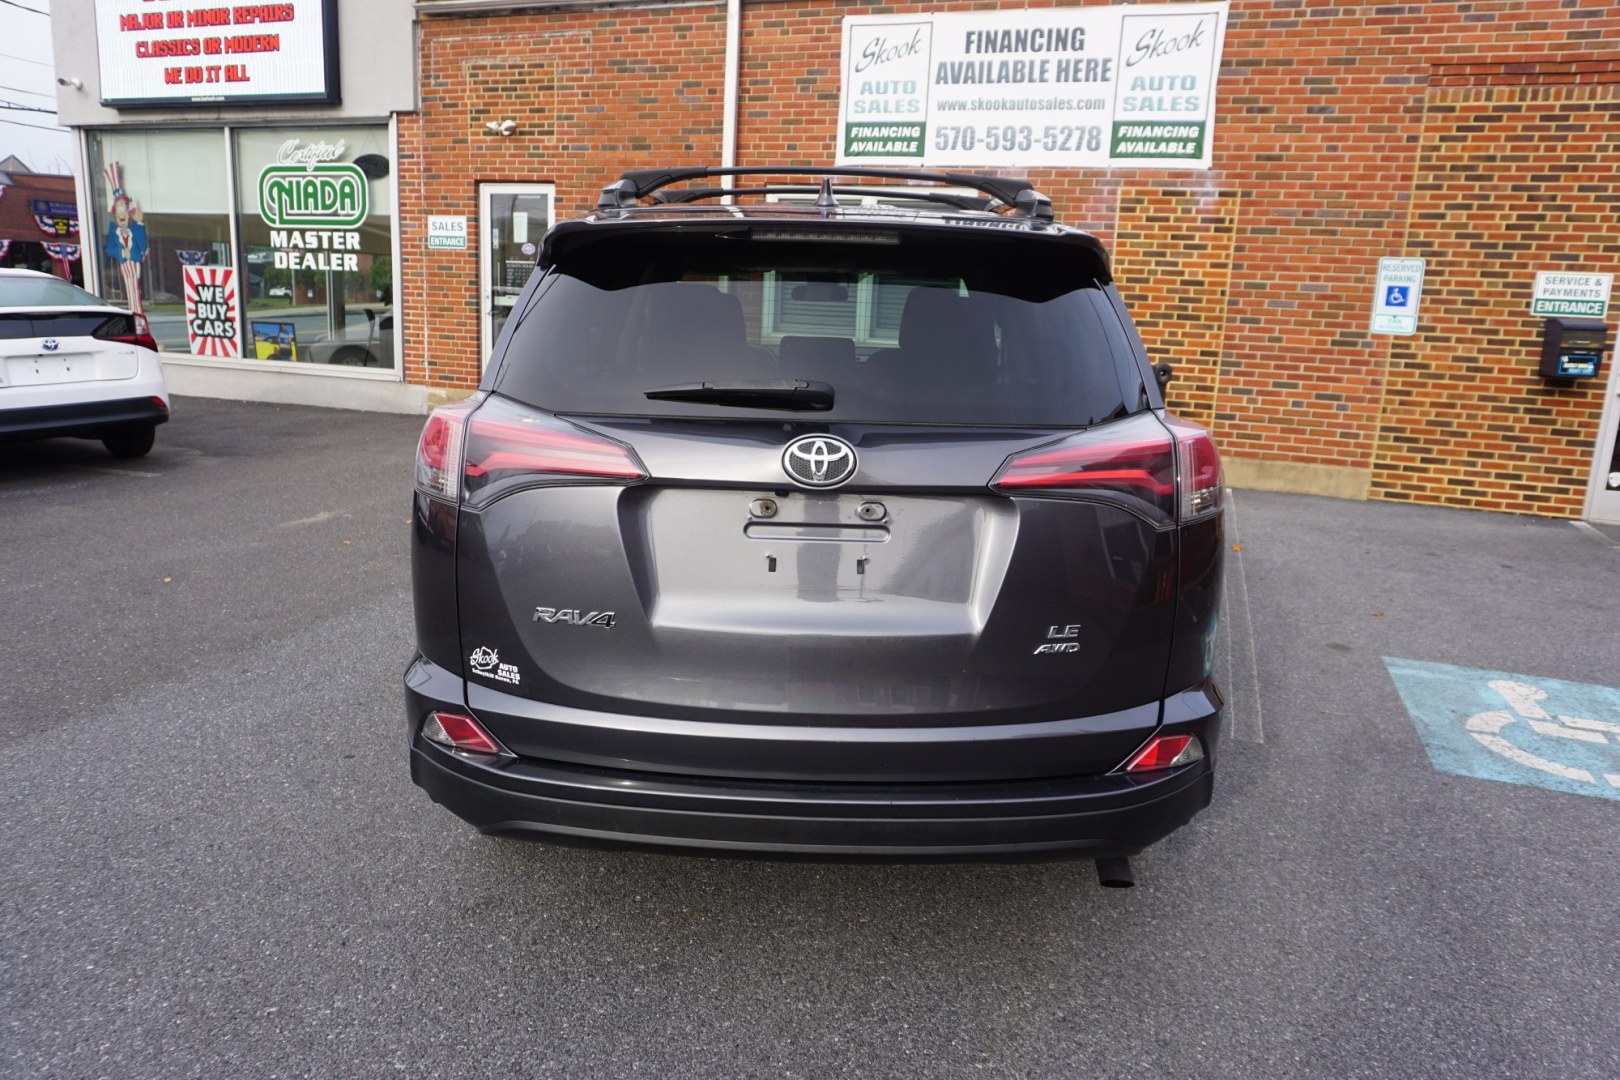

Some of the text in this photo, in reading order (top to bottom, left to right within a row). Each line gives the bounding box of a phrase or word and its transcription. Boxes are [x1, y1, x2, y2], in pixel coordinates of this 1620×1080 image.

[120, 3, 295, 31] MAJOR OR MINOR REPAIRS
[135, 34, 280, 58] CLASSICS OR MODERN
[965, 27, 1086, 55] FINANCING
[1126, 18, 1205, 67] Skook
[855, 27, 922, 73] Skook
[165, 64, 251, 85] WE DO IT ALL
[935, 57, 1113, 85] AVAILABLE HERE
[860, 80, 917, 95] AUTO
[1130, 74, 1197, 91] AUTO
[853, 99, 920, 114] SALES
[937, 96, 1106, 112] www.skookautosales.com
[1122, 96, 1200, 112] SALES
[850, 126, 921, 138] FINANCING
[935, 125, 1102, 152] 570-593-5278
[1117, 125, 1200, 138] FINANCING
[277, 138, 345, 171] Certified
[849, 141, 919, 152] AVAILABLE
[1116, 141, 1197, 154] AVAILABLE
[267, 177, 358, 214] NIADA
[431, 221, 464, 232] SALES
[270, 230, 361, 250] MASTER
[430, 237, 465, 247] ENTRANCE
[274, 251, 359, 271] DEALER
[1383, 263, 1421, 273] RESERVED
[1383, 274, 1417, 283] PARKING
[1545, 276, 1603, 287] SERVICE &
[198, 286, 225, 303] WE
[1543, 287, 1601, 298] PAYMENTS
[197, 303, 228, 320] BUY
[1536, 301, 1603, 314] ENTRANCE
[192, 320, 234, 338] CARS
[532, 606, 616, 629] RAV4
[1047, 624, 1081, 639] LE
[470, 647, 499, 666] Skook
[1033, 642, 1081, 655] AWD
[497, 669, 521, 681] SALES
[499, 662, 518, 673] AUTO
